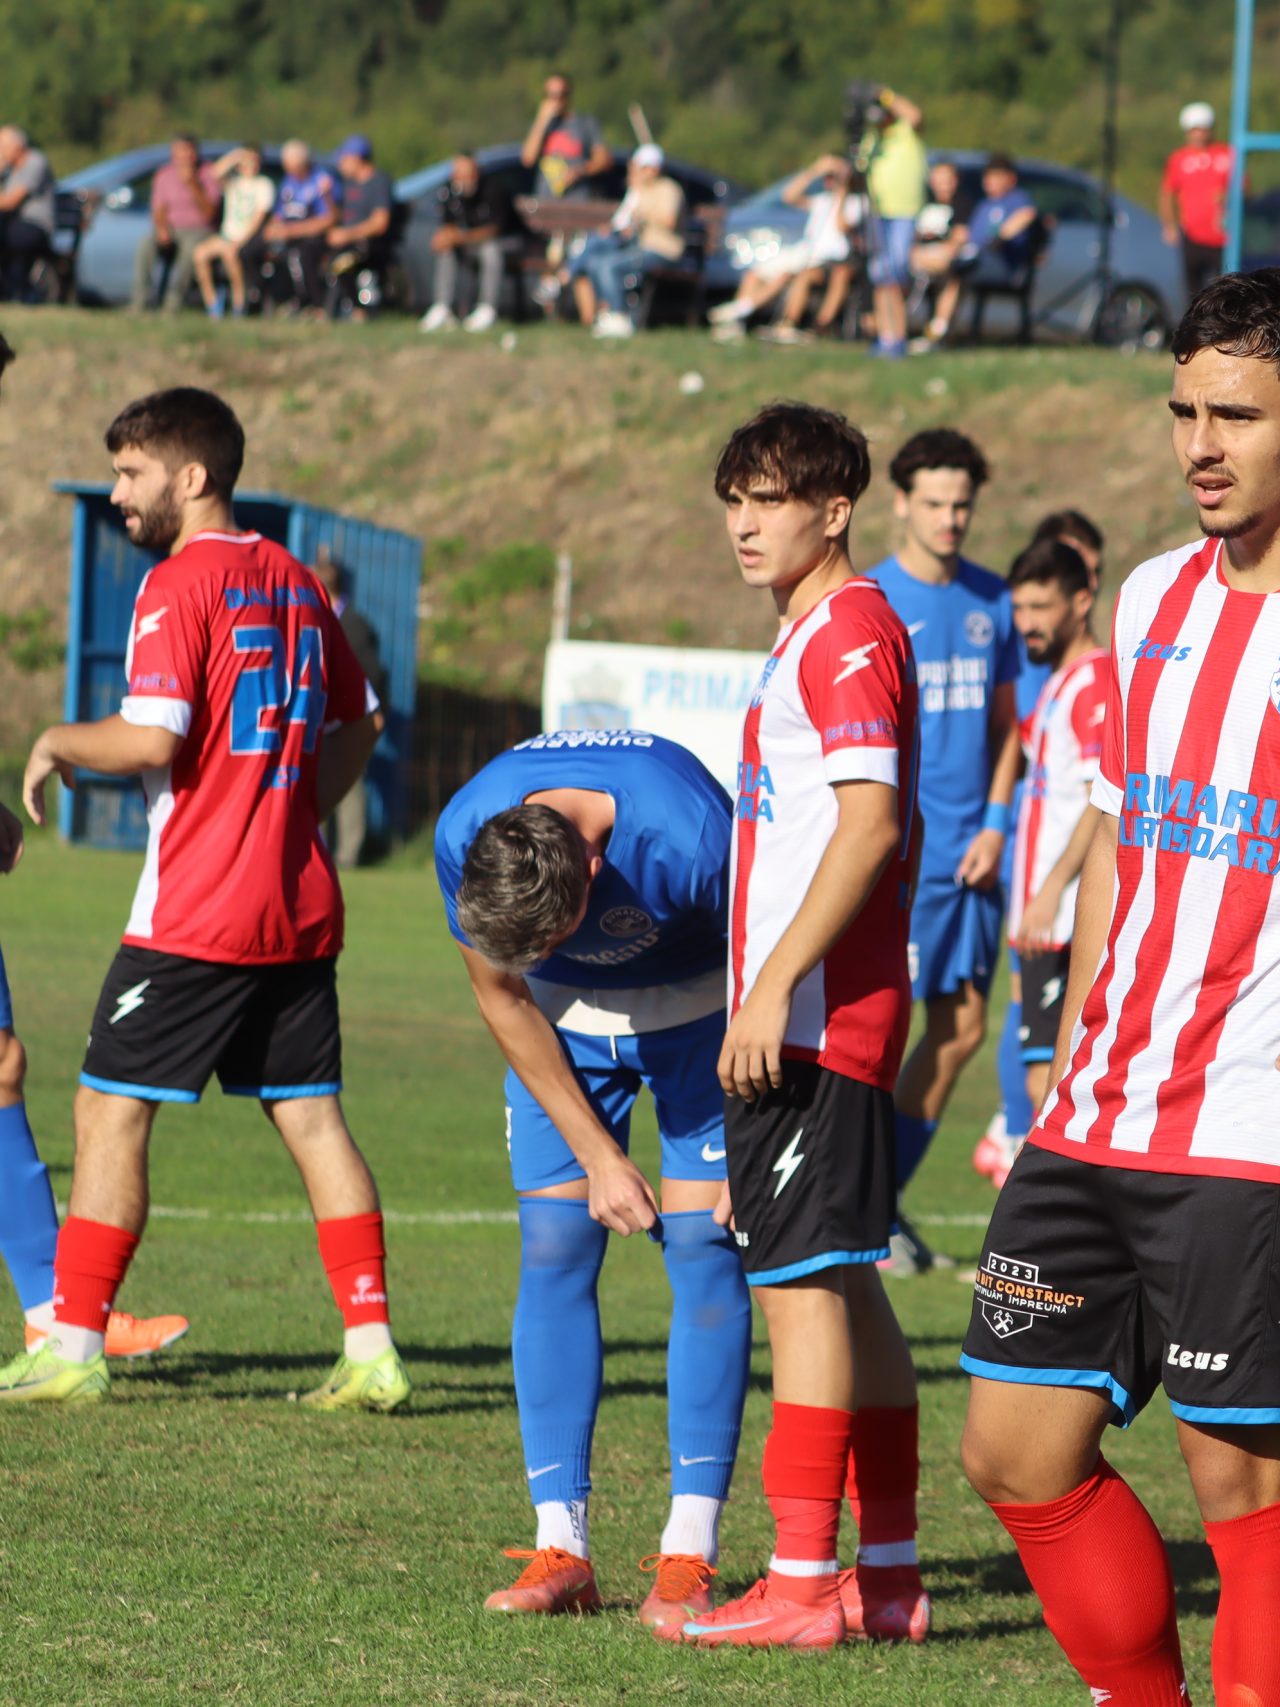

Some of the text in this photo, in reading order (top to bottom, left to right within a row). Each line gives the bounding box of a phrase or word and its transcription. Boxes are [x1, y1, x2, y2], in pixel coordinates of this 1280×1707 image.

[1133, 638, 1192, 661] Zeus
[228, 625, 328, 756] 24
[990, 1259, 1033, 1280] 2023
[995, 1279, 1085, 1308] CONSTRUCT
[1167, 1343, 1230, 1371] Zeus
